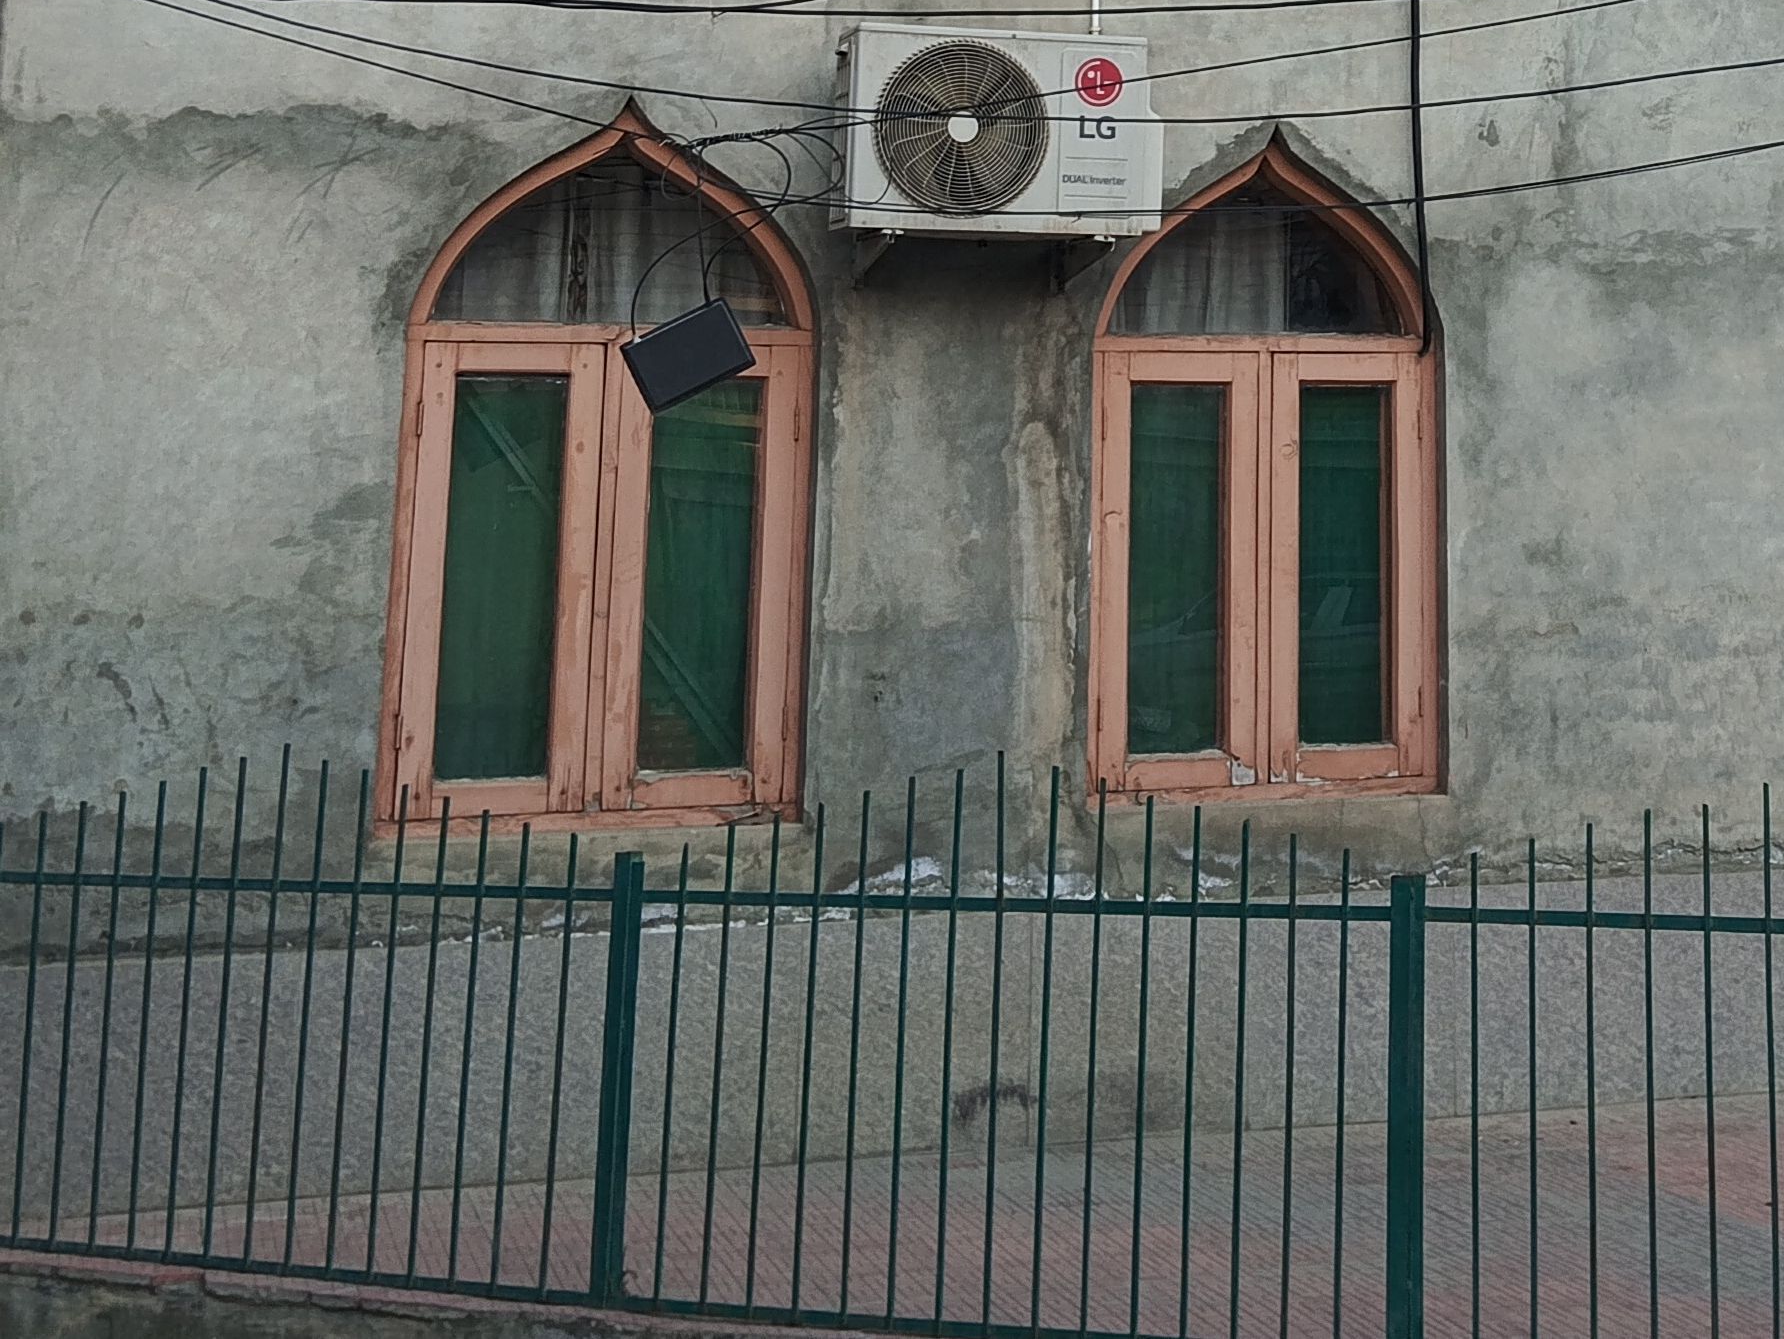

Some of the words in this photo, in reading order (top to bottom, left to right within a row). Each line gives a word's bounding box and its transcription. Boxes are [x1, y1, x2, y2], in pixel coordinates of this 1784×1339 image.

[1079, 115, 1116, 139] LG
[1062, 174, 1088, 184] DUAL
[1090, 176, 1127, 186] Inverter
